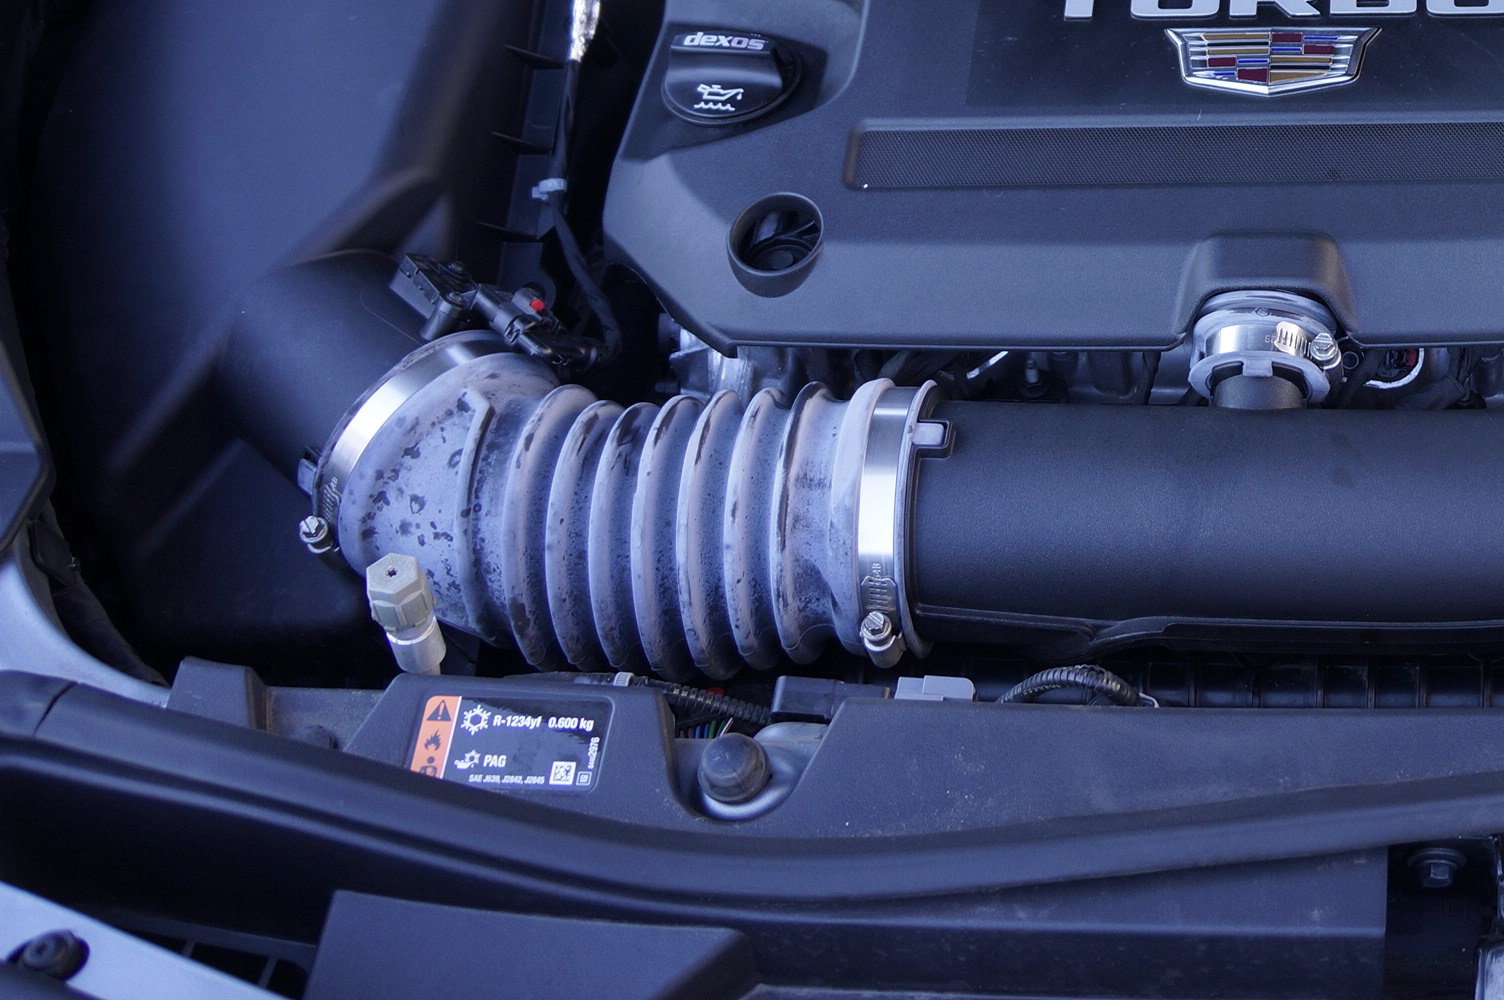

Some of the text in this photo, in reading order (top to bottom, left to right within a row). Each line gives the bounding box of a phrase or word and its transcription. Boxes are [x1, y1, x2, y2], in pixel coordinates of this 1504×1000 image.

[683, 31, 766, 51] dexos
[493, 715, 594, 731] R-1234yf 0.600 kg
[483, 755, 507, 768] PAG
[469, 774, 483, 783] SAE
